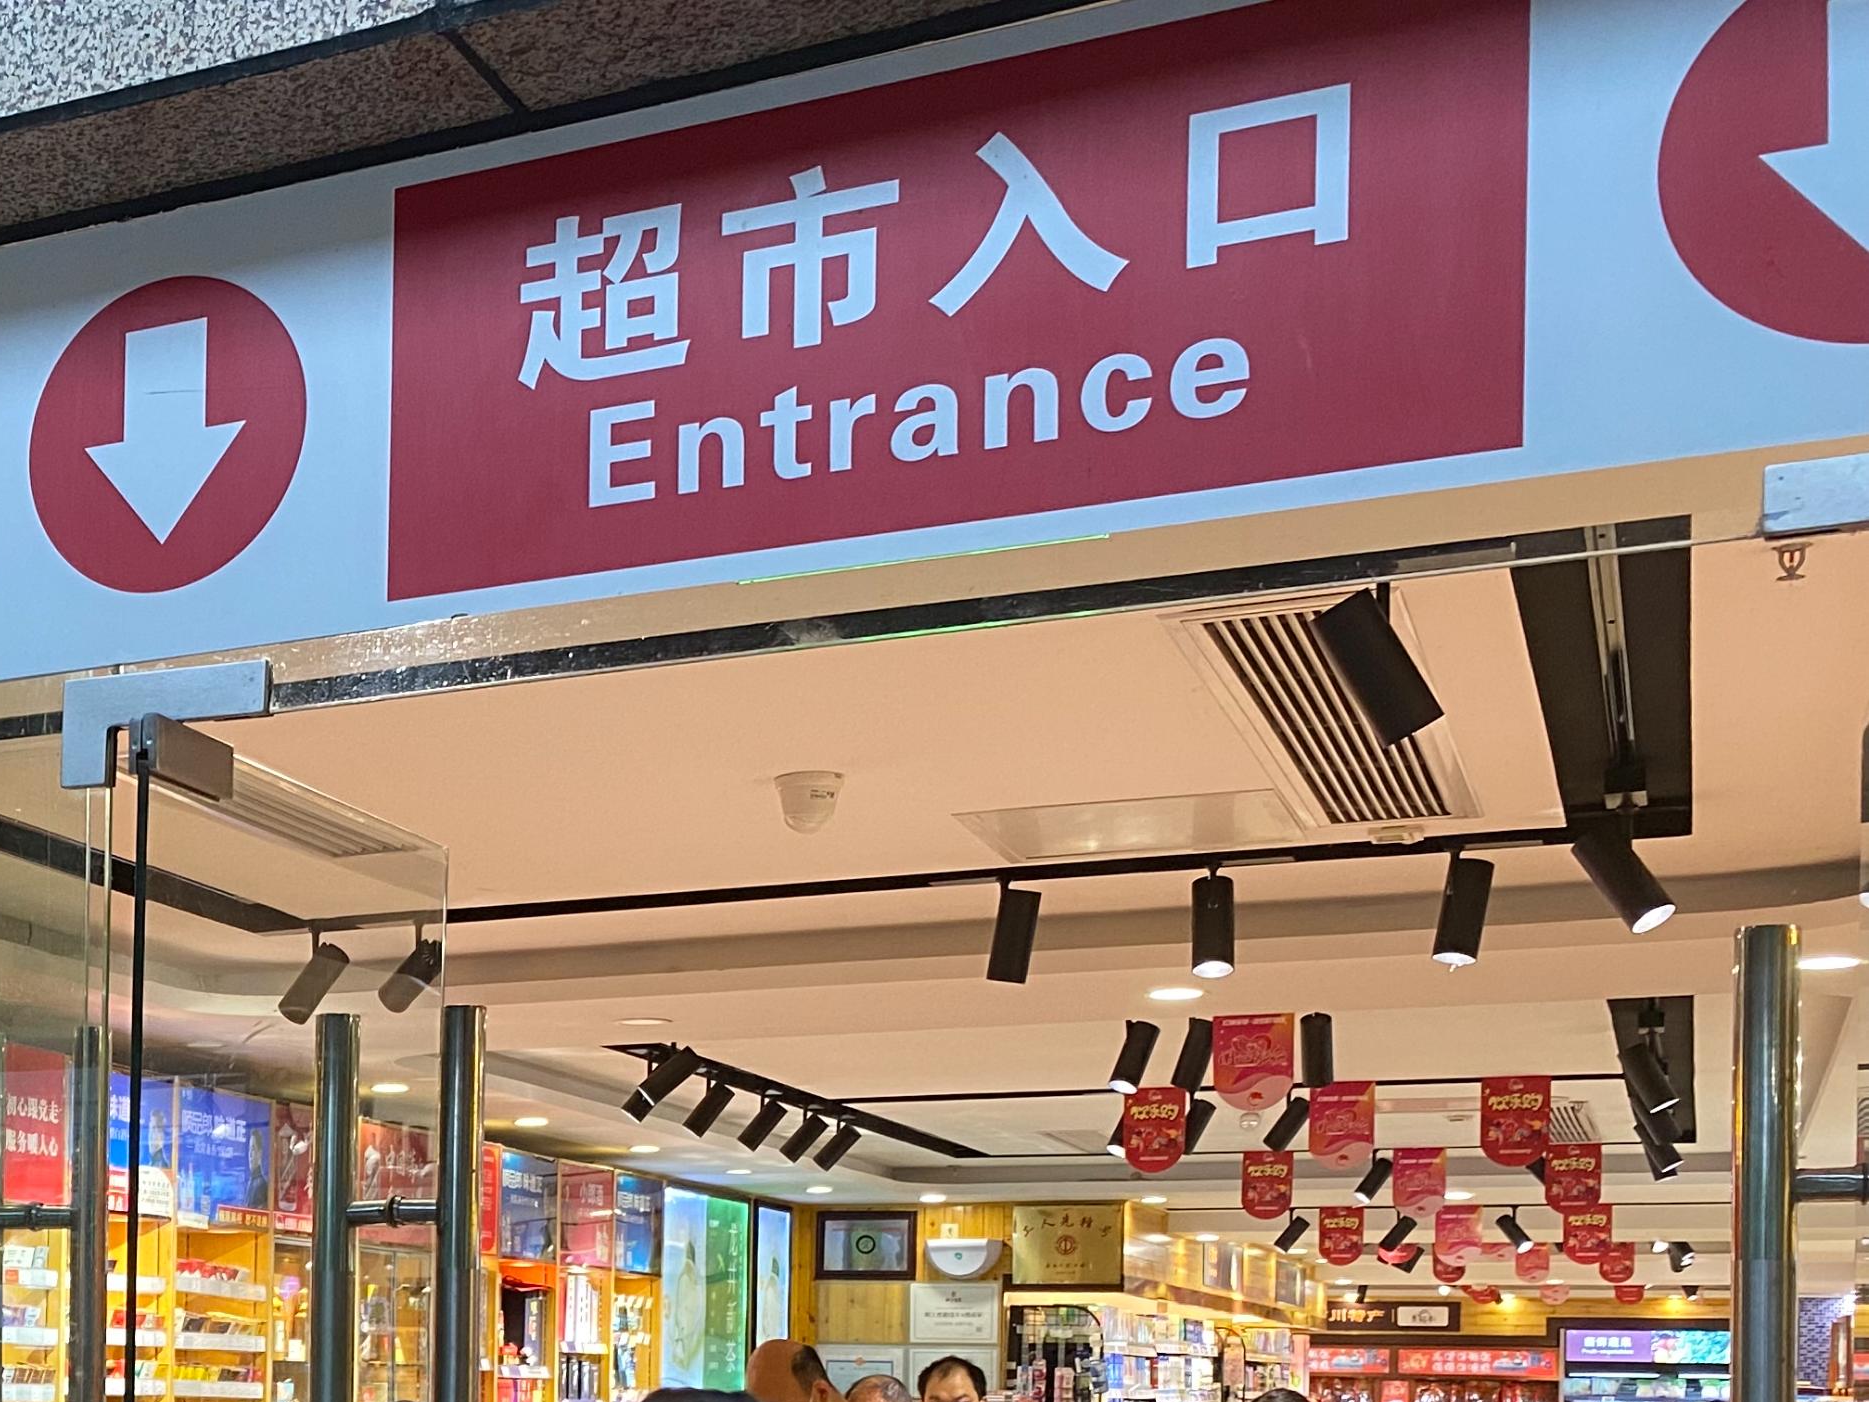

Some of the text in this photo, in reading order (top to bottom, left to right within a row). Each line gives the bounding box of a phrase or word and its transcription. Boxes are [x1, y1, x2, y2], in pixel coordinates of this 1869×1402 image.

[518, 83, 1352, 391] 超市入口
[587, 337, 1252, 508] Entrance
